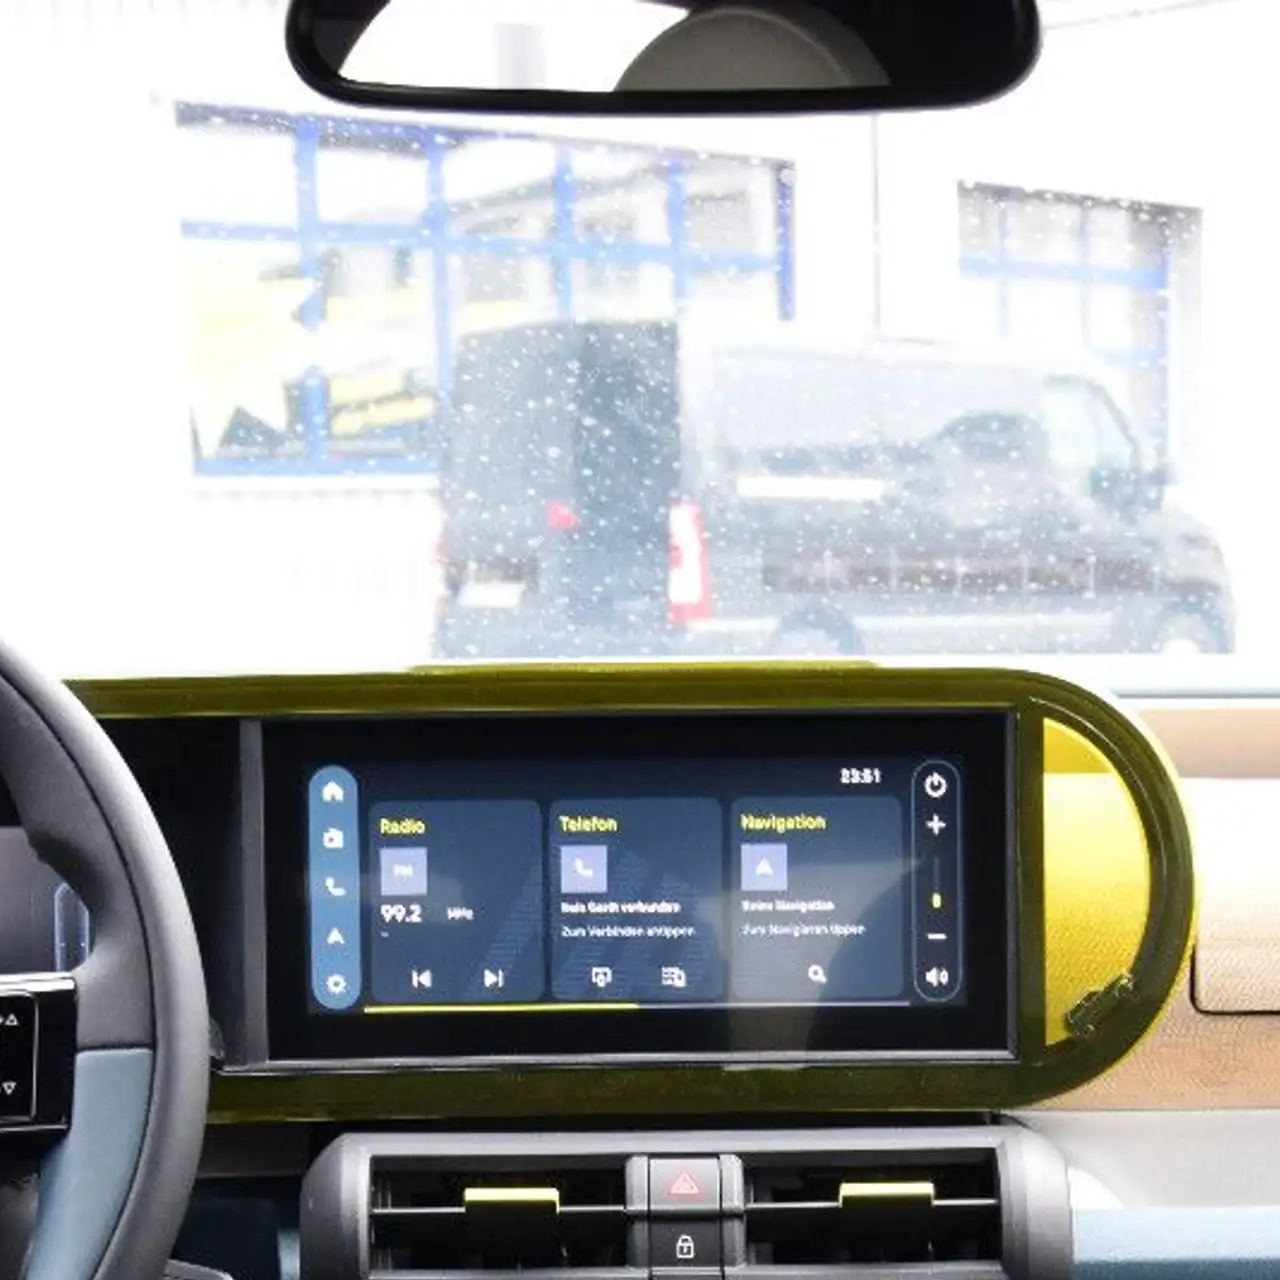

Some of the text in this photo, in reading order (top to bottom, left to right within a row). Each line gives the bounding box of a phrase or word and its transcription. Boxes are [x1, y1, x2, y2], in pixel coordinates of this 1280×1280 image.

[380, 818, 426, 834] Radio
[559, 815, 618, 832] Telefon
[740, 813, 827, 834] Navigation
[380, 904, 422, 923] 99.2
